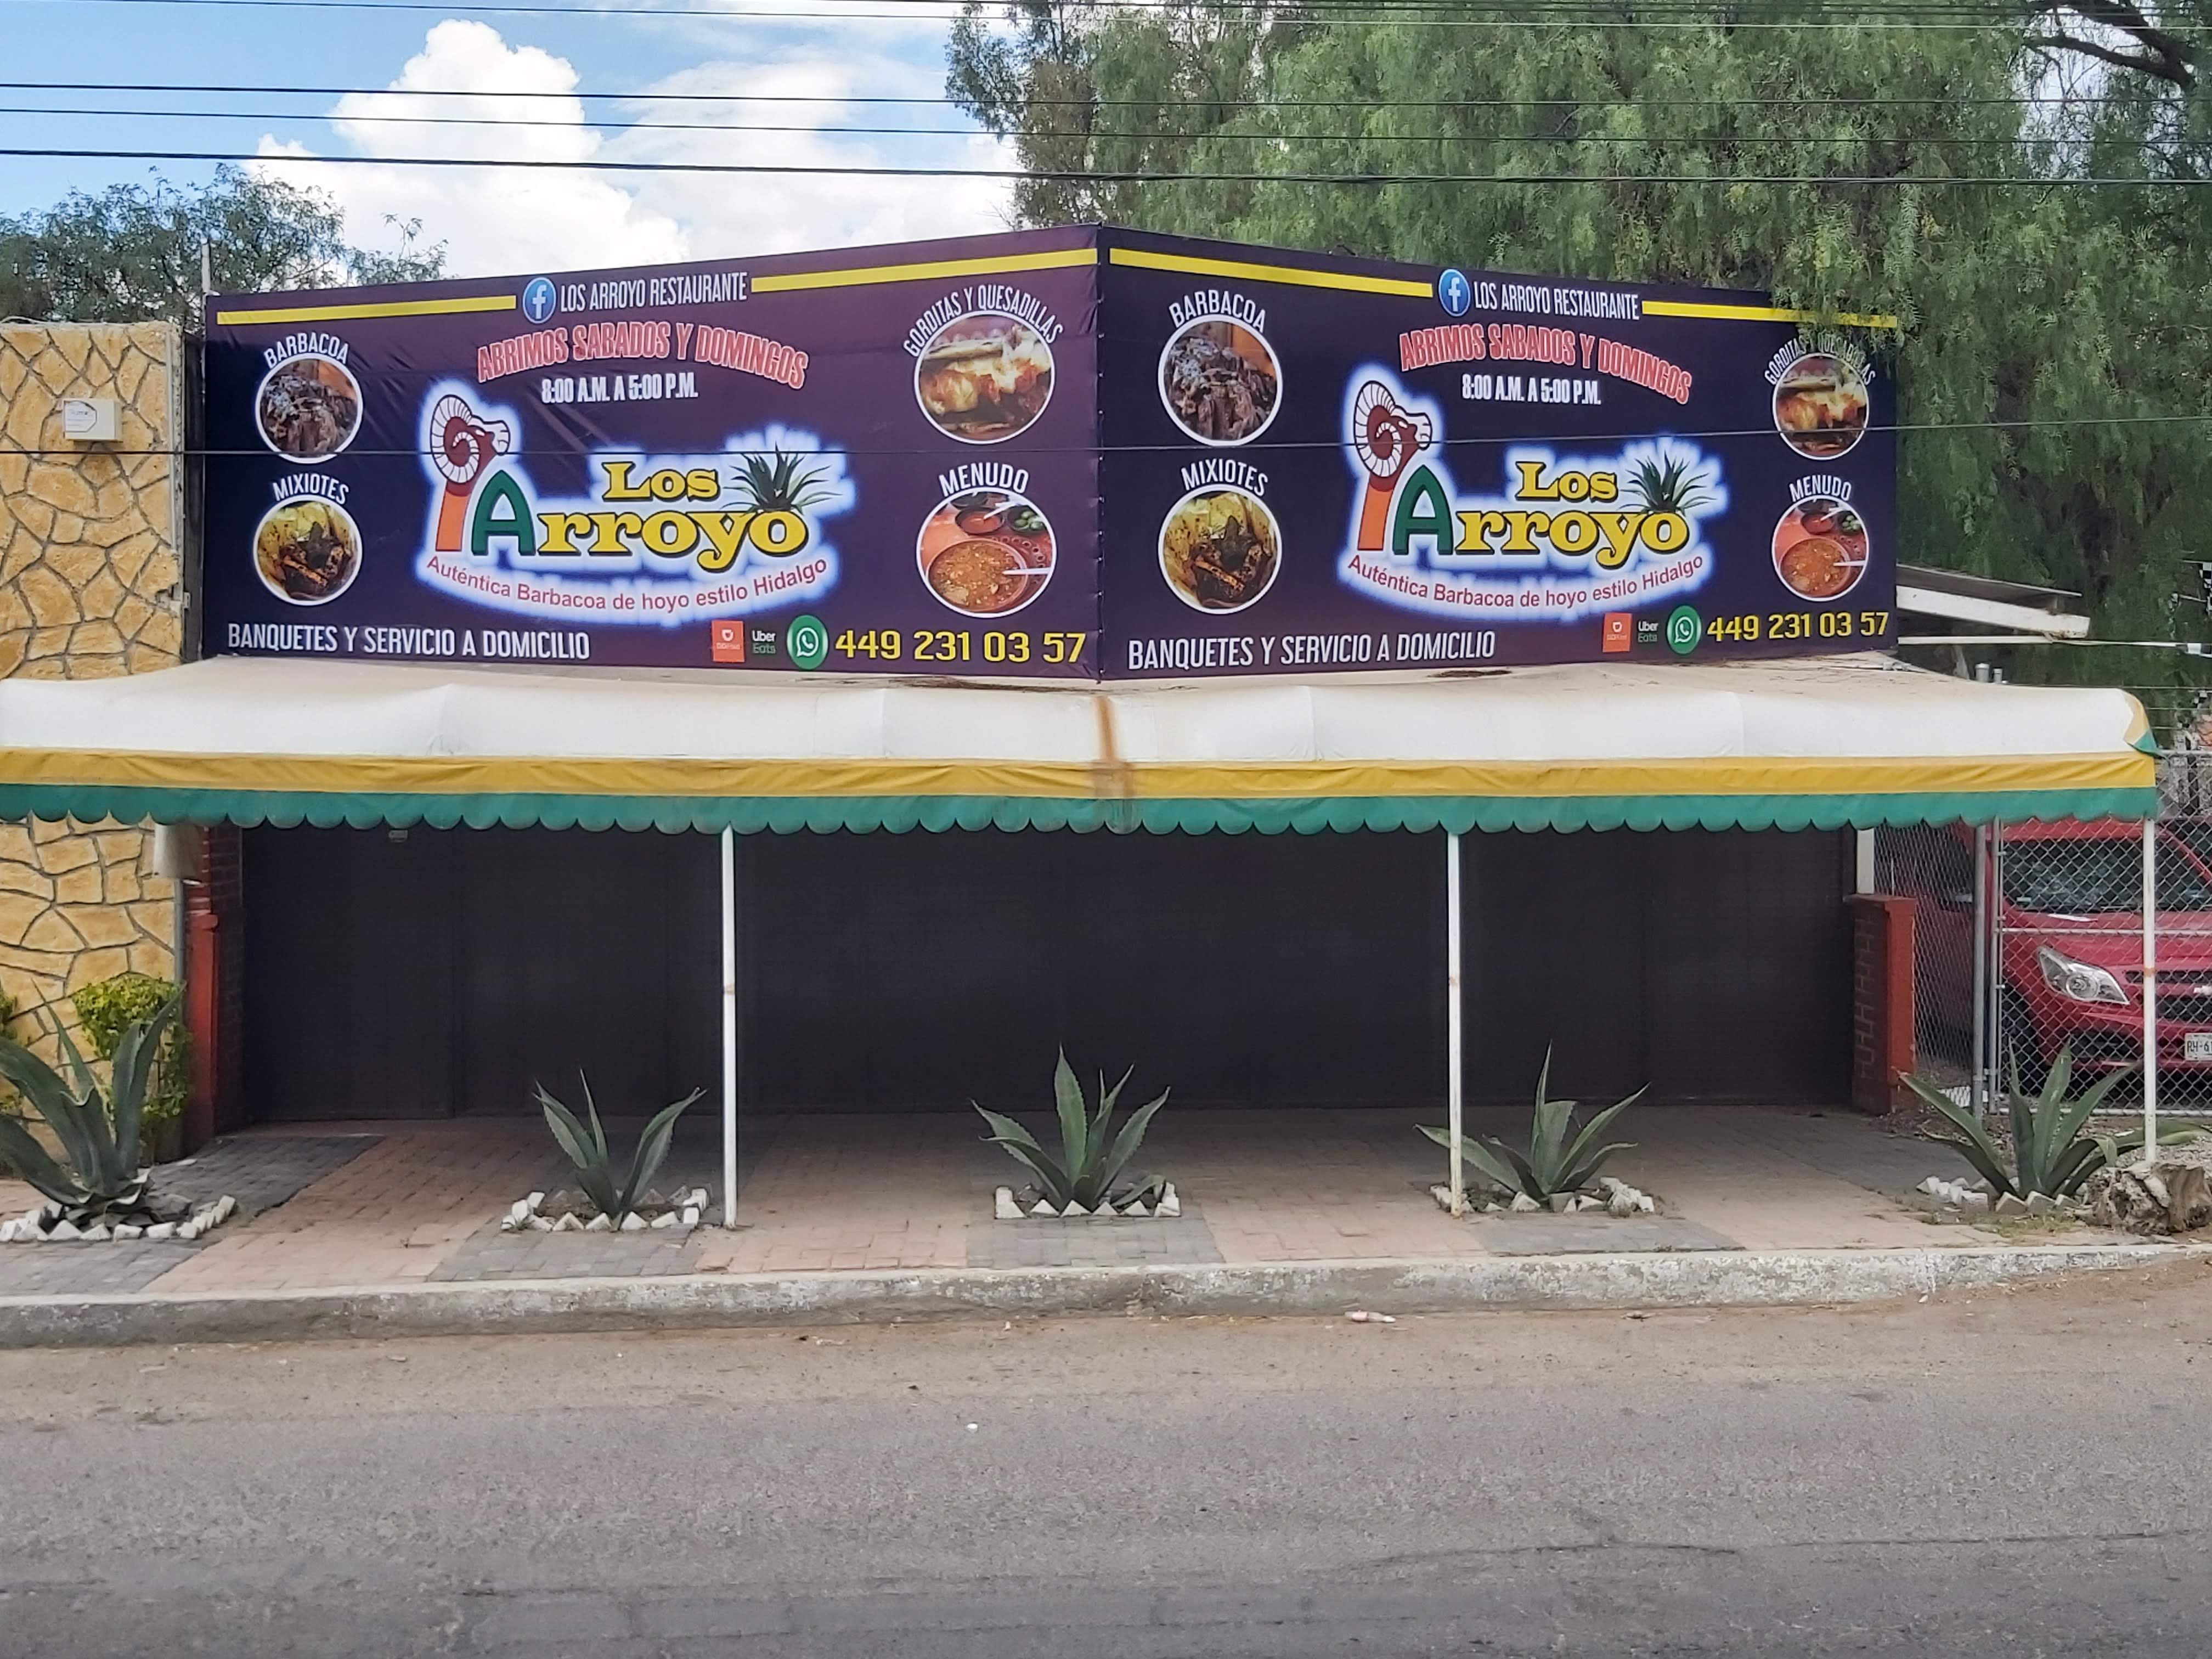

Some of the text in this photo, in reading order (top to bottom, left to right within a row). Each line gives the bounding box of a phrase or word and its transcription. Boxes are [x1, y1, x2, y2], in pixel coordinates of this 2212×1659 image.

[532, 289, 546, 319] f
[561, 272, 747, 313] LOS ARROYO RESTAURANTE
[1168, 289, 1266, 333] BARBACOA
[1448, 278, 1461, 312] f
[1474, 281, 1640, 321] LOS ARROYO RESTAURANTE
[903, 284, 1063, 358] GORDITAS Y QUESADILLAS
[264, 332, 348, 369] BARBACOA
[478, 321, 809, 389] ABRIMOS SABADOS Y DOMINGOS
[1399, 323, 1692, 405] ABRIMOS SABADOS Y DOMINGOS
[1764, 334, 1807, 385] GORDITAS
[541, 372, 698, 404] 8:00 A.M. A 5:00 P.M.
[1462, 374, 1601, 405] 8:00 A.M. A 5:00 P.M.
[273, 473, 349, 505] MIXIOTES
[602, 462, 720, 502] Los
[938, 462, 1029, 496] MENUDO
[1181, 459, 1268, 496] MIXIOTES
[1515, 461, 1618, 503] Los
[1789, 474, 1852, 502] MENUDO
[471, 470, 809, 573] Arroyo
[1392, 464, 1689, 570] Arroyo
[426, 555, 827, 614] Auténtica Barbacoa de hoyo estilo Hidalgo
[1348, 553, 1704, 611] Auténtica Barbacoa de hoyo estilo Hidalgo
[228, 623, 590, 659] BANQUETES Y SERVICIO A DOMICILIO
[752, 630, 776, 642] Uber
[1638, 620, 1659, 631] Uber
[1707, 611, 1889, 642] 449 231 03 57
[834, 629, 1087, 663] 449 231 03 57
[1128, 630, 1496, 671] BANQUETES Y SERVICIO A DOMICILIO
